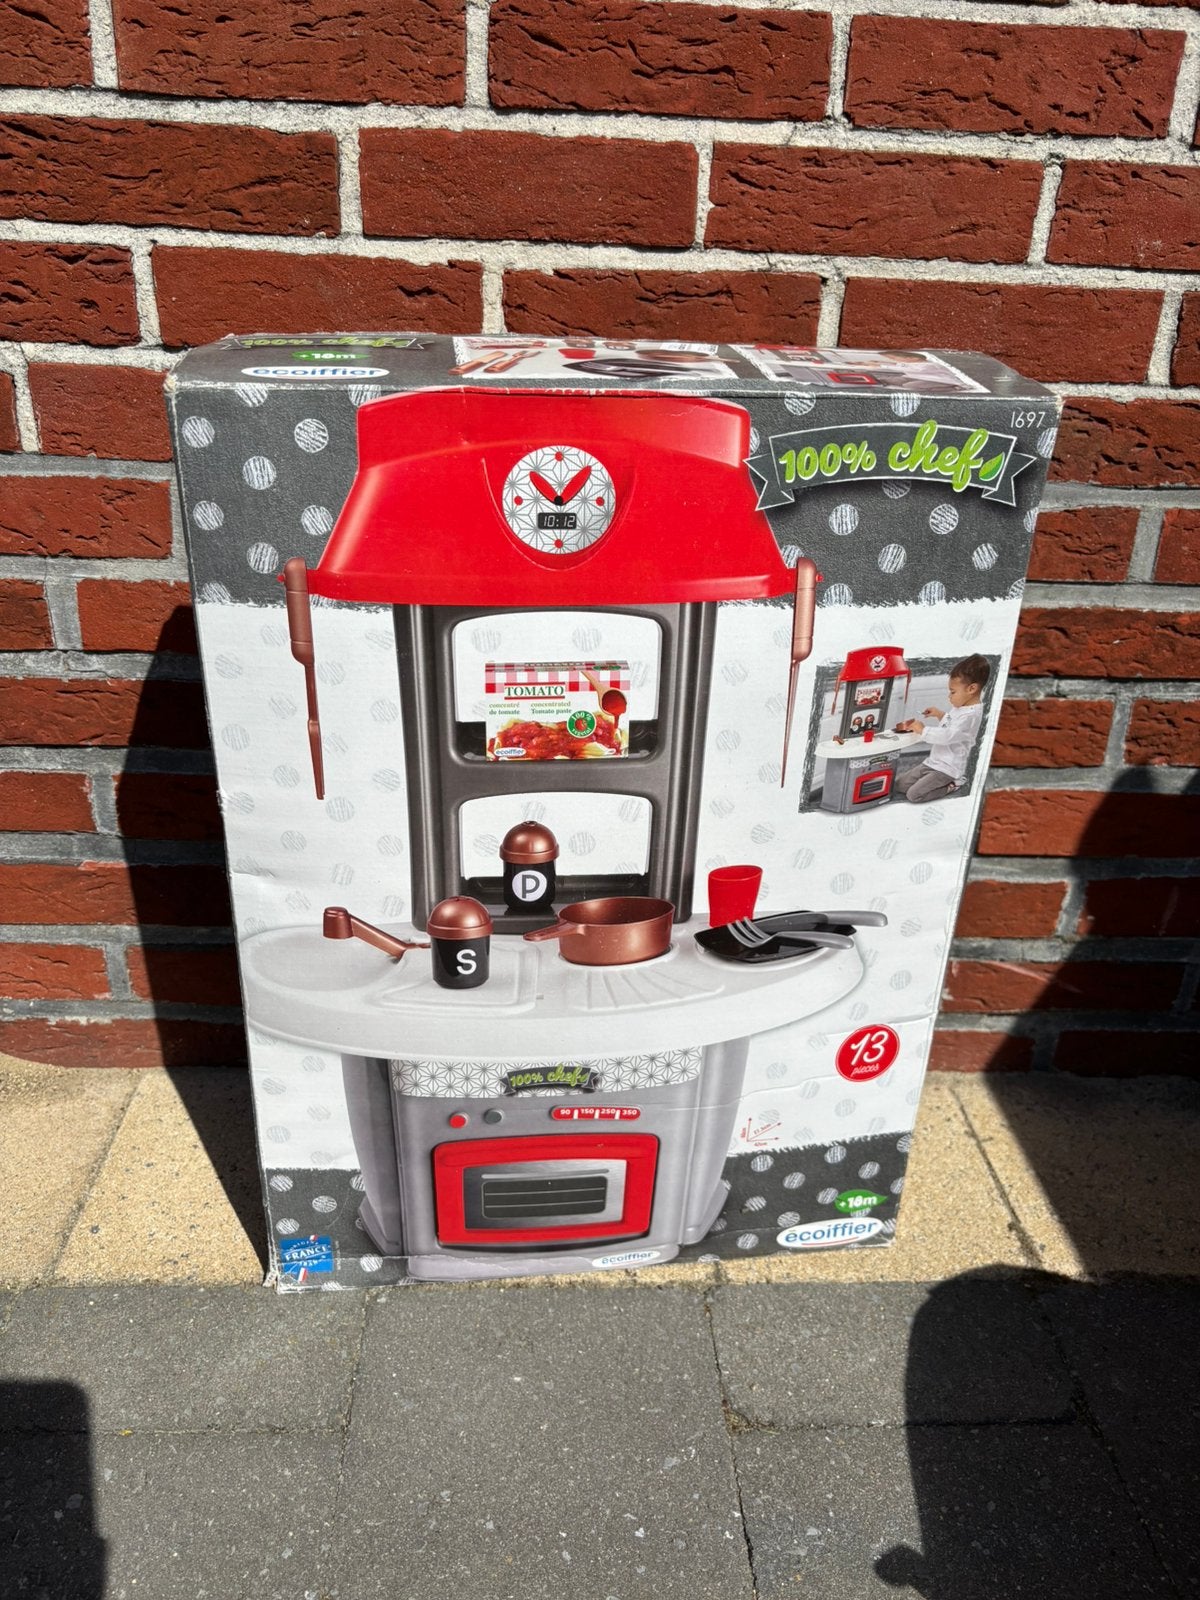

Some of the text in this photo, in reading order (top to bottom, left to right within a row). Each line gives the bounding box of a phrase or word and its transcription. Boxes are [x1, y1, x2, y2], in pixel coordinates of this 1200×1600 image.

[1010, 411, 1046, 428] 1697
[778, 420, 989, 492] 100% chef
[543, 515, 575, 527] 10:12
[506, 685, 565, 696] TOMATO
[521, 874, 541, 899] P
[456, 949, 477, 975] S
[850, 1030, 889, 1066] 13
[510, 1063, 582, 1086] 100% chef
